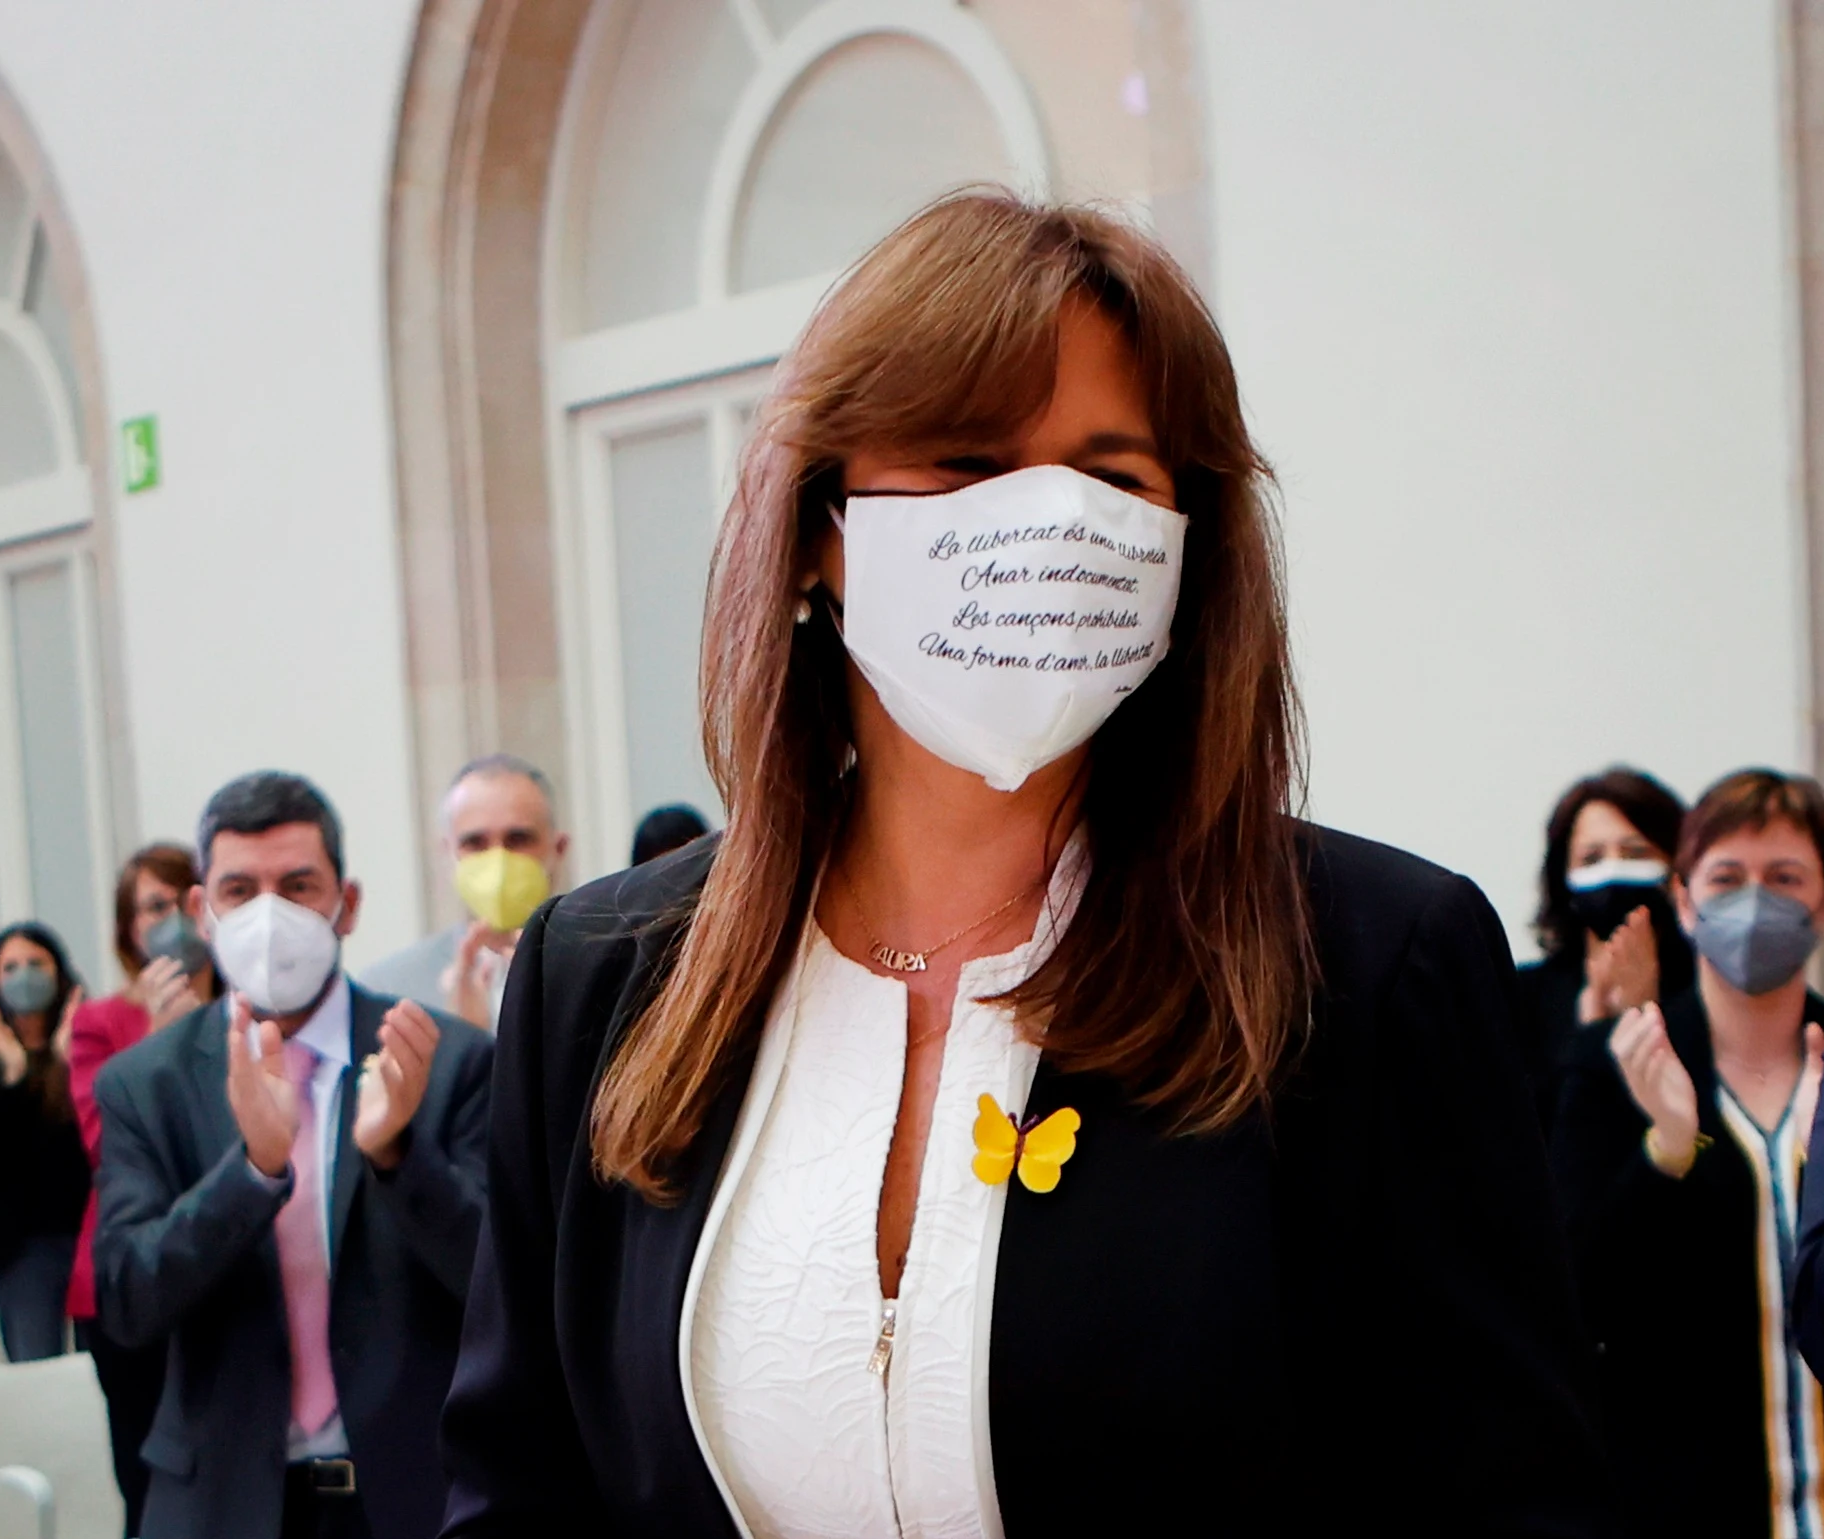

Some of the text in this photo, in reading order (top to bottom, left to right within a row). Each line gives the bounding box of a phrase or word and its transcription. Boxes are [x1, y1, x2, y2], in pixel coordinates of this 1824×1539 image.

[928, 530, 963, 561] La
[966, 523, 1061, 554] llibertat
[1063, 522, 1086, 542] és
[1089, 533, 1117, 553] una
[961, 560, 1034, 592] Anar
[952, 600, 992, 631] Les
[994, 611, 1076, 637] cançons
[918, 631, 968, 662] Una
[964, 644, 1033, 671] forma
[1095, 650, 1109, 670] la
